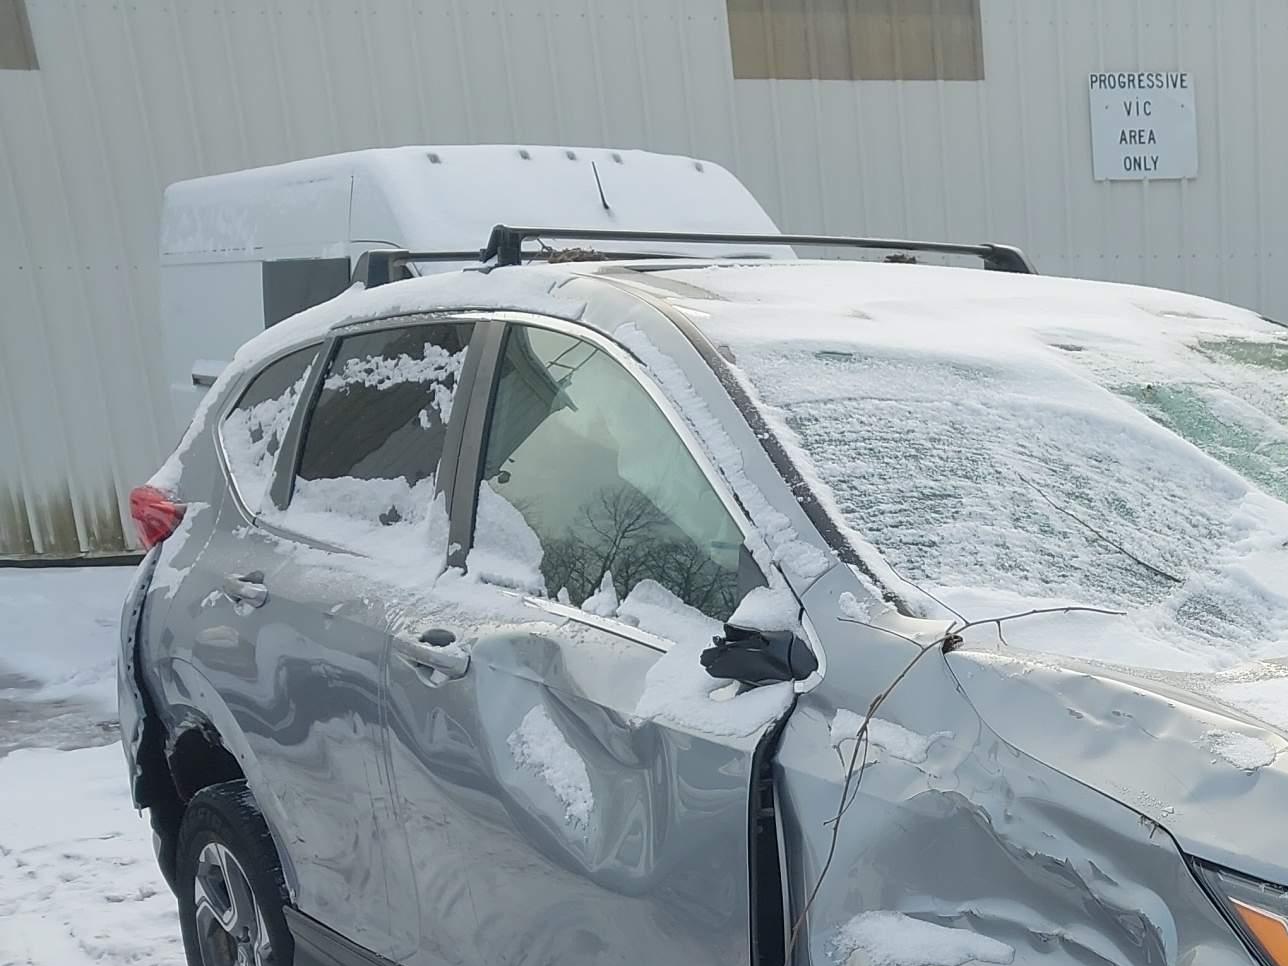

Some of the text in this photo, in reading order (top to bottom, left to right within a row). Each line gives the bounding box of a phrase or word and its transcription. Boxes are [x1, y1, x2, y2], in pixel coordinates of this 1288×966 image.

[1089, 73, 1188, 89] PROGRESSIVE
[1123, 100, 1152, 117] VIC
[1119, 129, 1157, 145] AREA
[1123, 155, 1159, 171] ONLY
